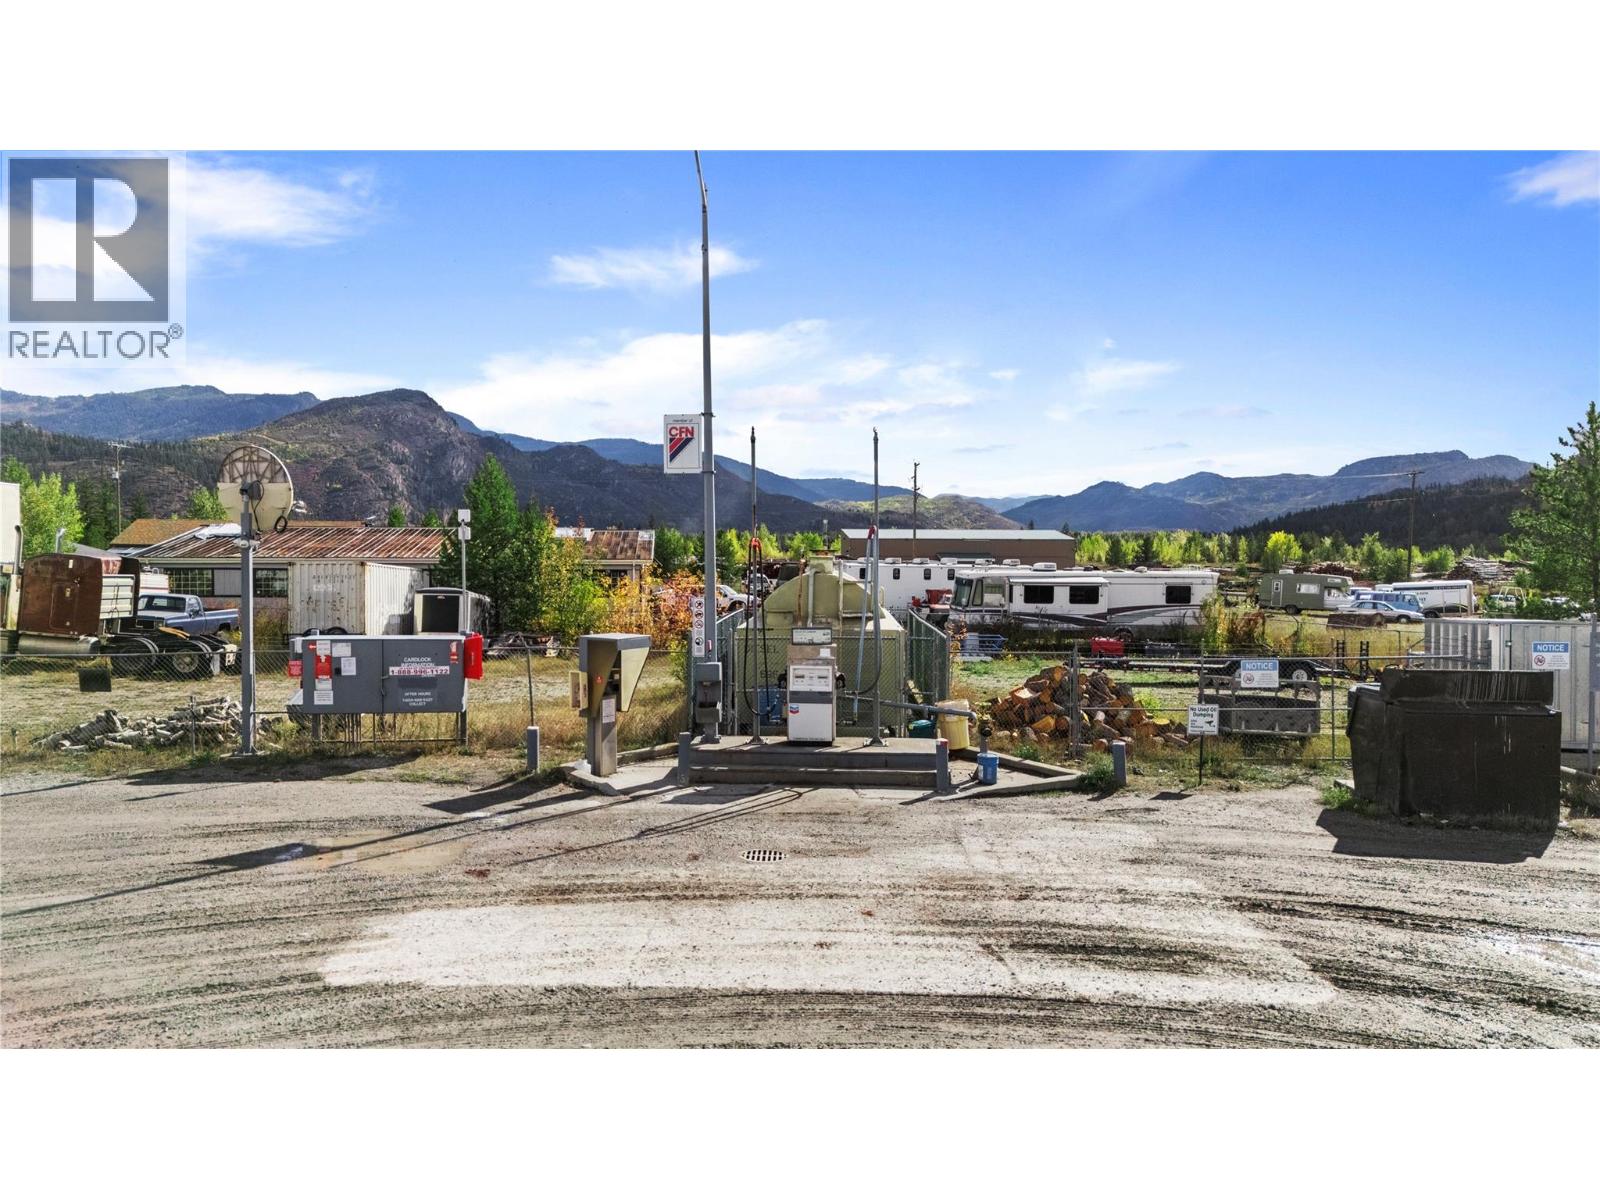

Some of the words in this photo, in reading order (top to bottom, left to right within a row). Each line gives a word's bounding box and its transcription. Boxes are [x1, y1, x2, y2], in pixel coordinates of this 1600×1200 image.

[668, 426, 695, 437] CFN
[1536, 644, 1565, 652] NOTICE
[1245, 662, 1274, 670] NOTICE
